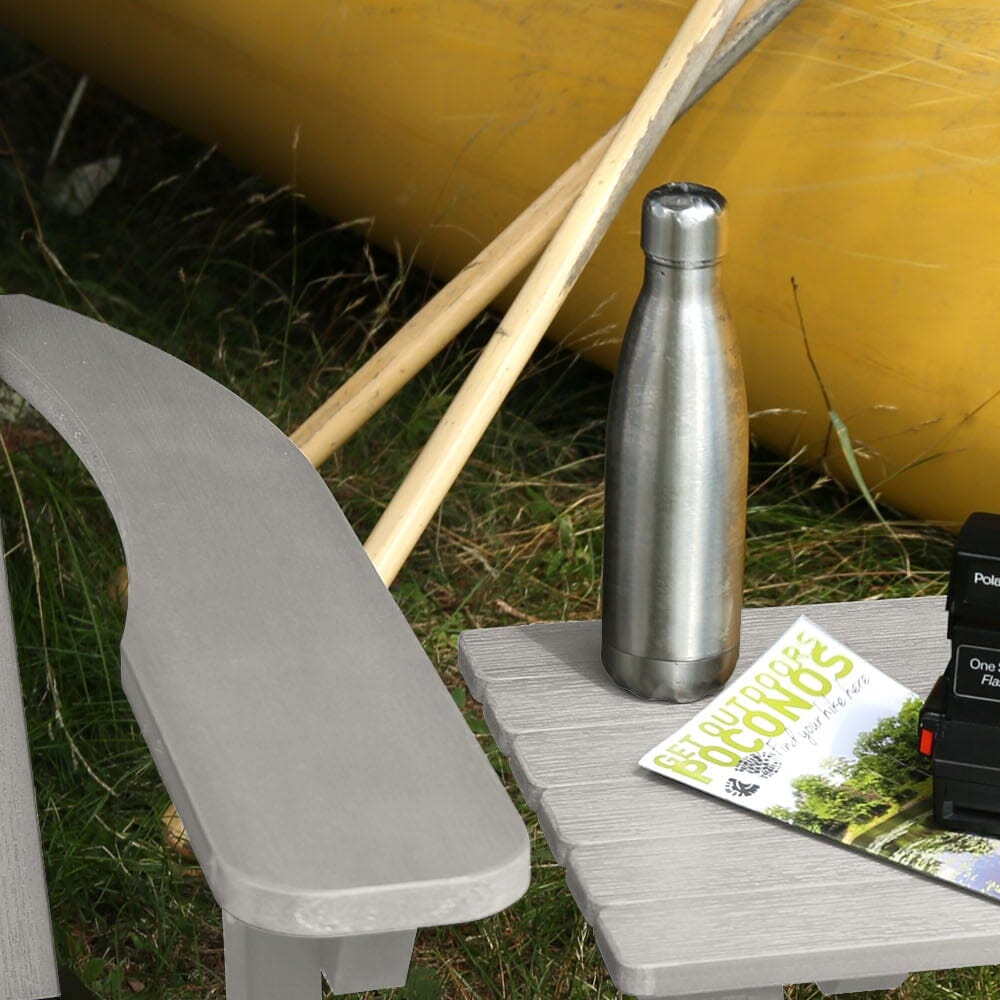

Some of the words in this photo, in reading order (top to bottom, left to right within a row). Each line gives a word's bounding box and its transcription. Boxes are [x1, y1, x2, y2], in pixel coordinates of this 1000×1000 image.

[653, 734, 703, 770] GET
[699, 631, 818, 738] OUTDOORS
[671, 640, 854, 785] POCONOS
[799, 715, 822, 746] your
[813, 693, 846, 720] hike
[835, 674, 870, 700] here
[969, 657, 996, 673] One
